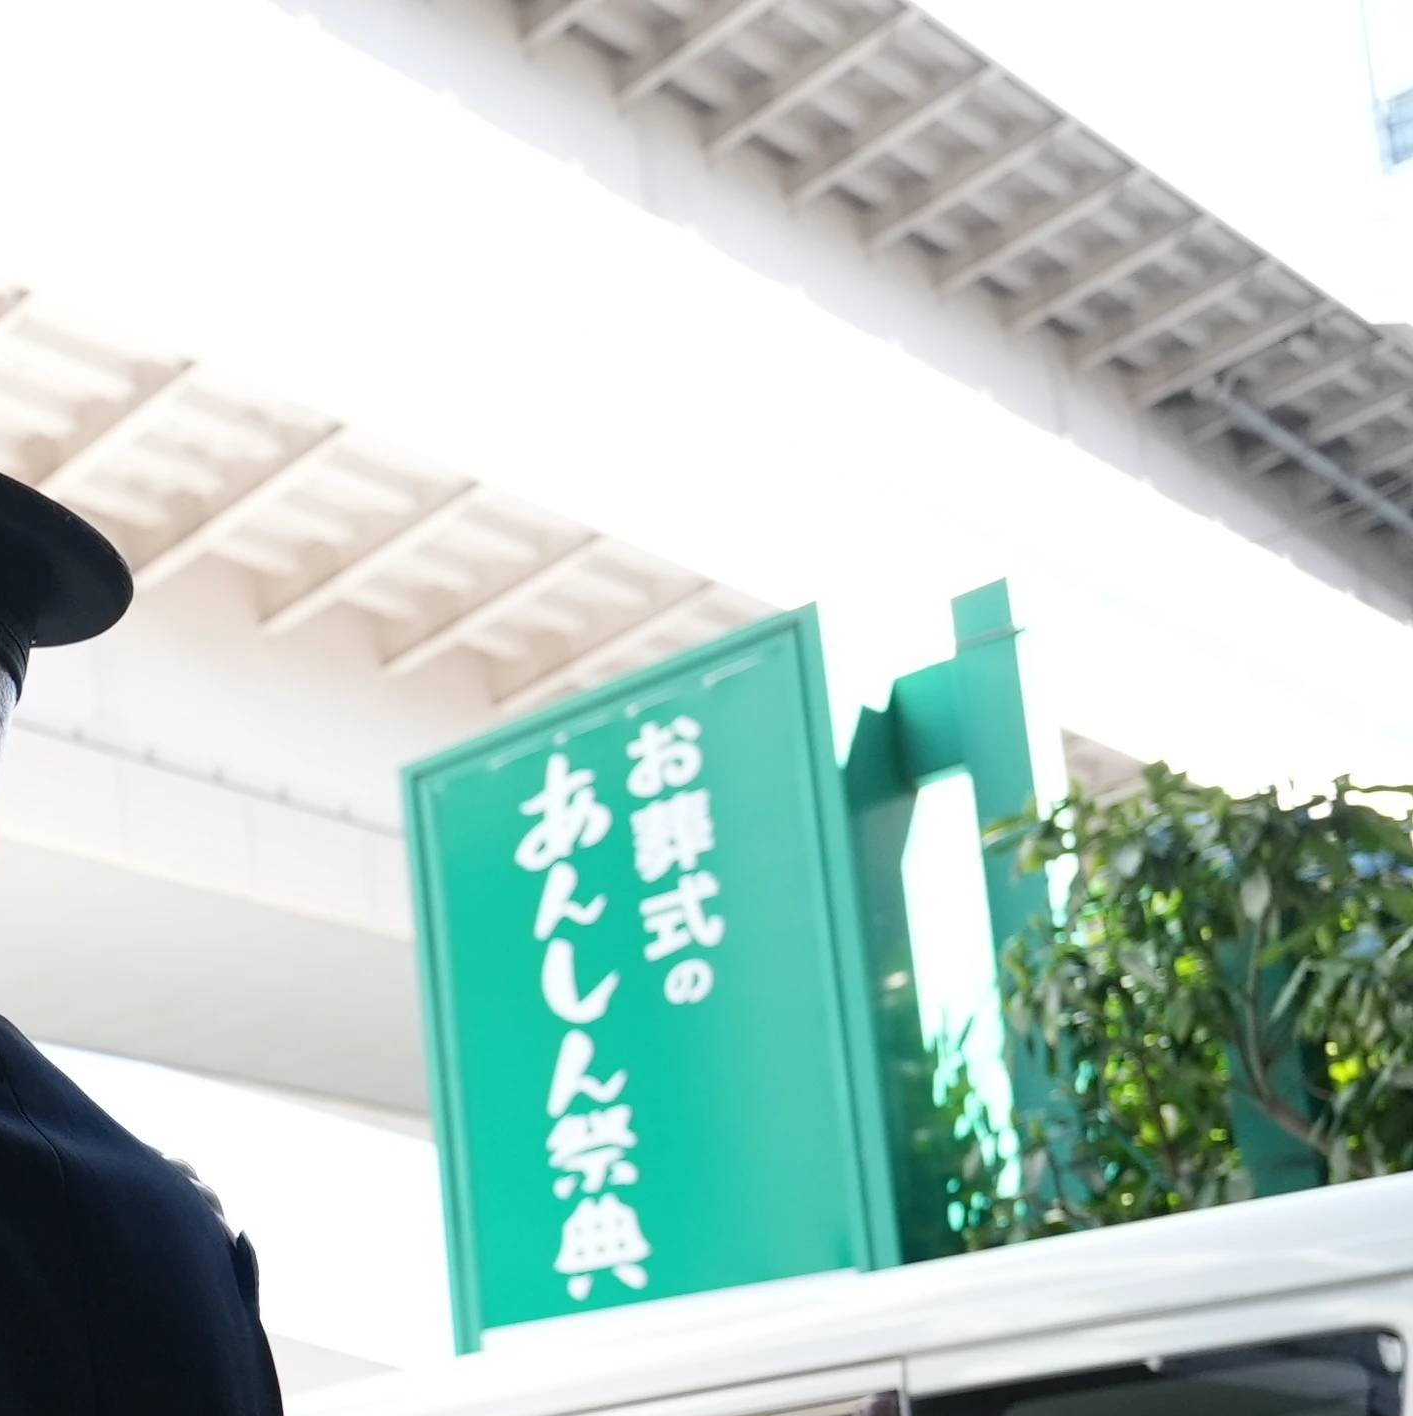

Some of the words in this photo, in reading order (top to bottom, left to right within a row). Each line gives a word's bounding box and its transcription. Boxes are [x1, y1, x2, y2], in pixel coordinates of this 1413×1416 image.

[514, 753, 652, 1301] あんしん祭典
